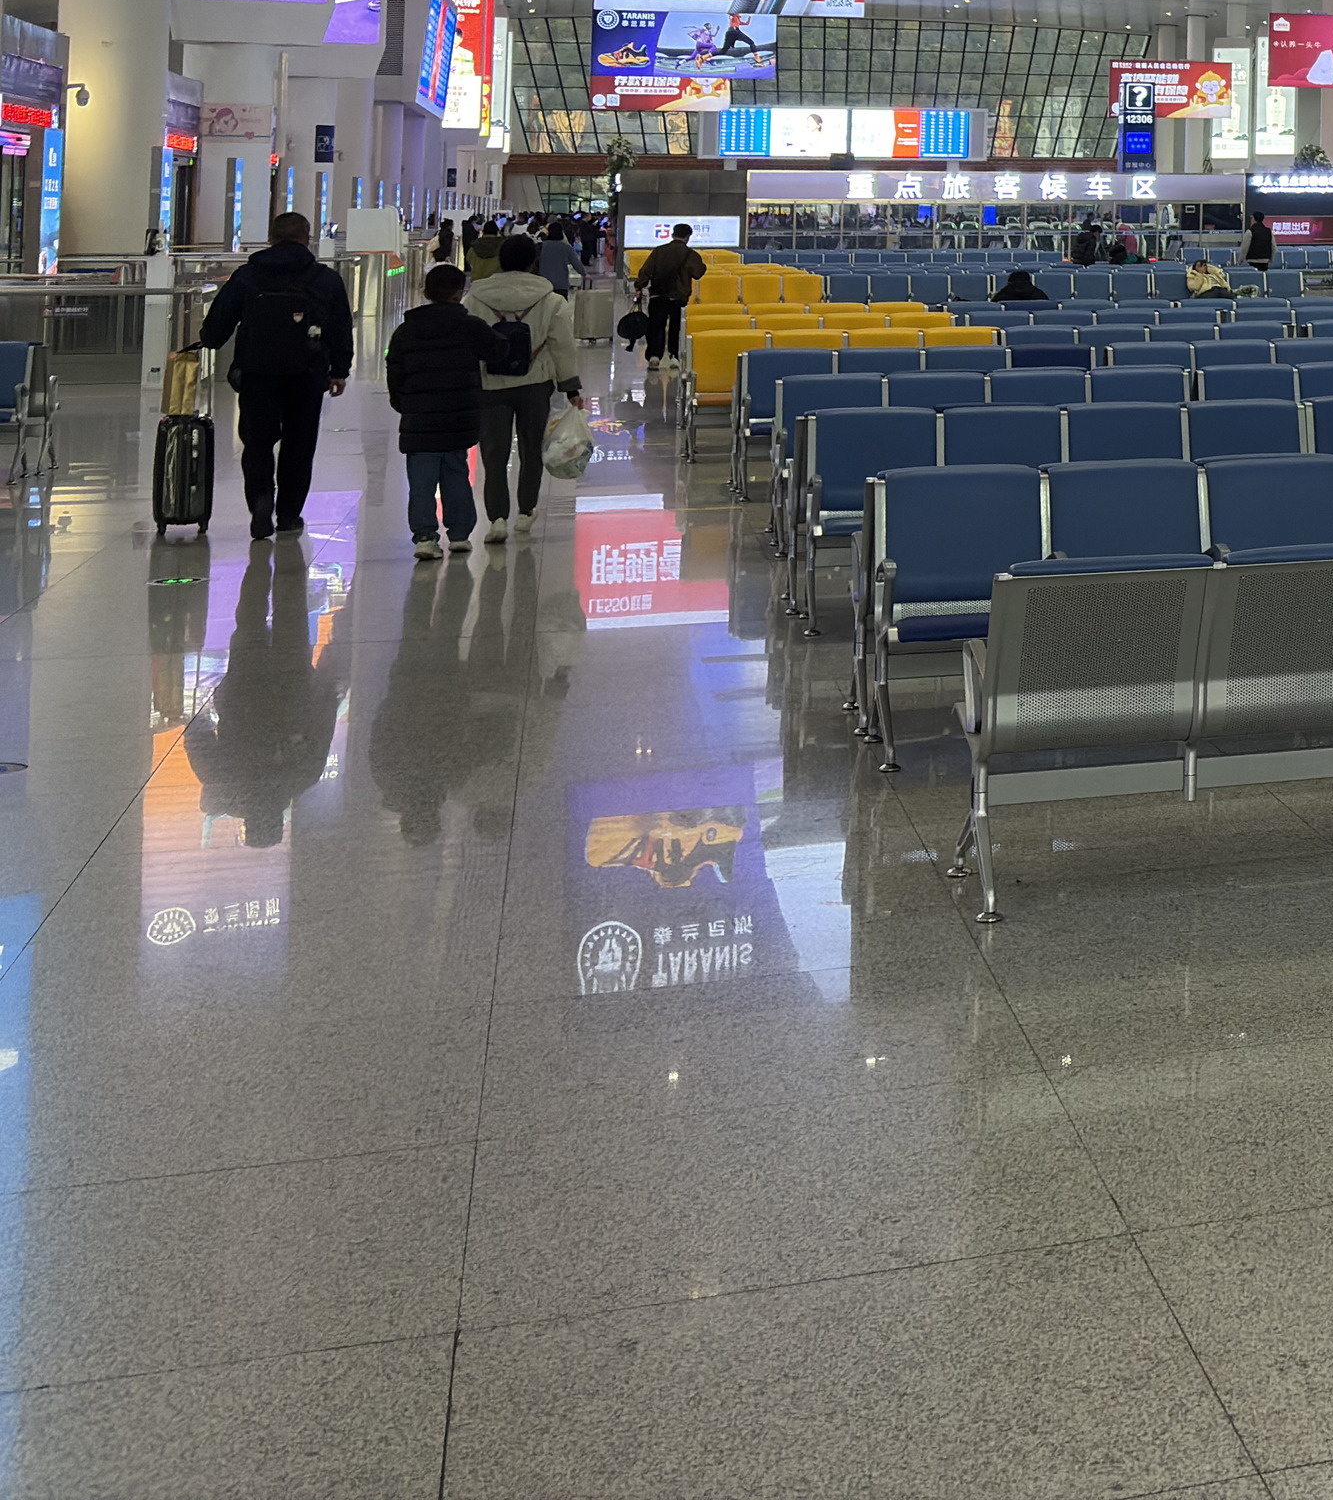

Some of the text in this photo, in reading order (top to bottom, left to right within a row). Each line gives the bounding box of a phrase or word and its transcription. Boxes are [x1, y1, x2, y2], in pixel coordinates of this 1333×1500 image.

[622, 12, 656, 20] TARANIS
[1126, 115, 1153, 124] 12306
[846, 173, 1157, 200] 重点旅客候车区
